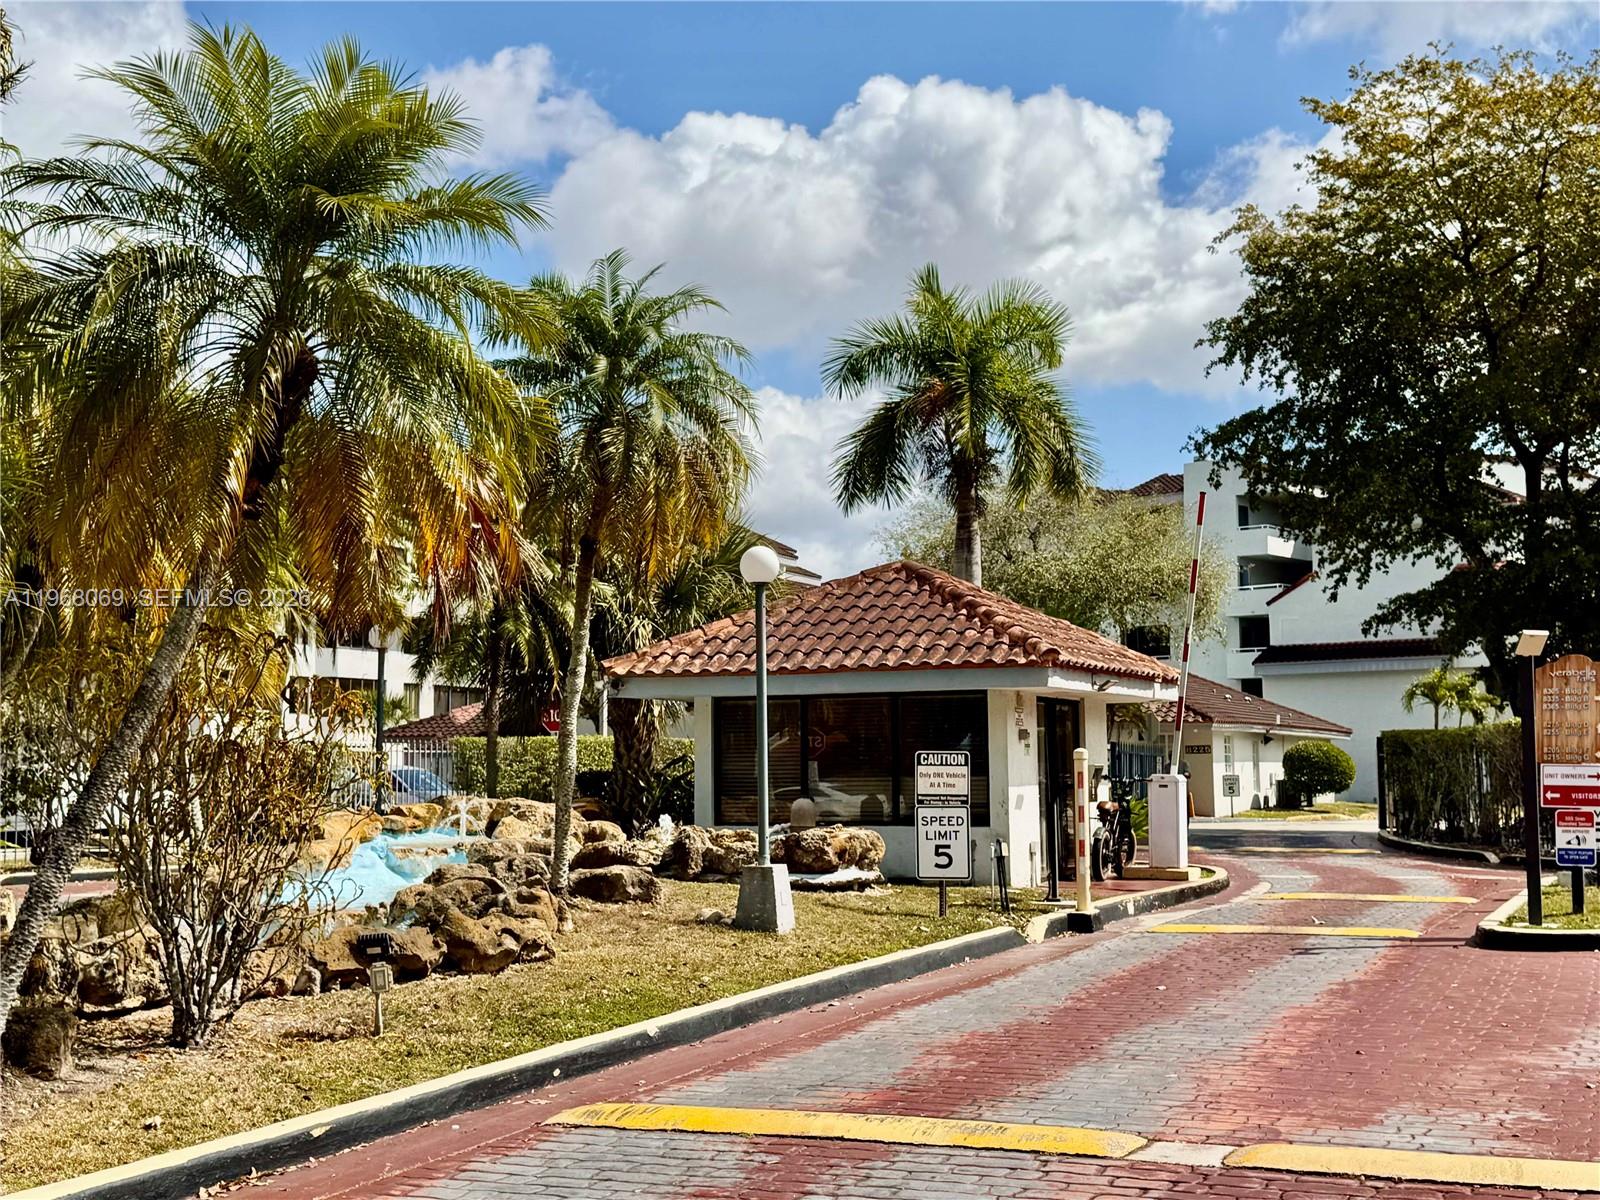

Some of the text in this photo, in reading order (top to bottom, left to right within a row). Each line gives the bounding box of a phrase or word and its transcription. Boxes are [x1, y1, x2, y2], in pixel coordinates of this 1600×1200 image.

[920, 754, 965, 765] CAUTION
[1228, 786, 1235, 794] 5
[921, 816, 964, 826] SPEED
[925, 830, 960, 840] LIMIT
[934, 844, 953, 869] 5
